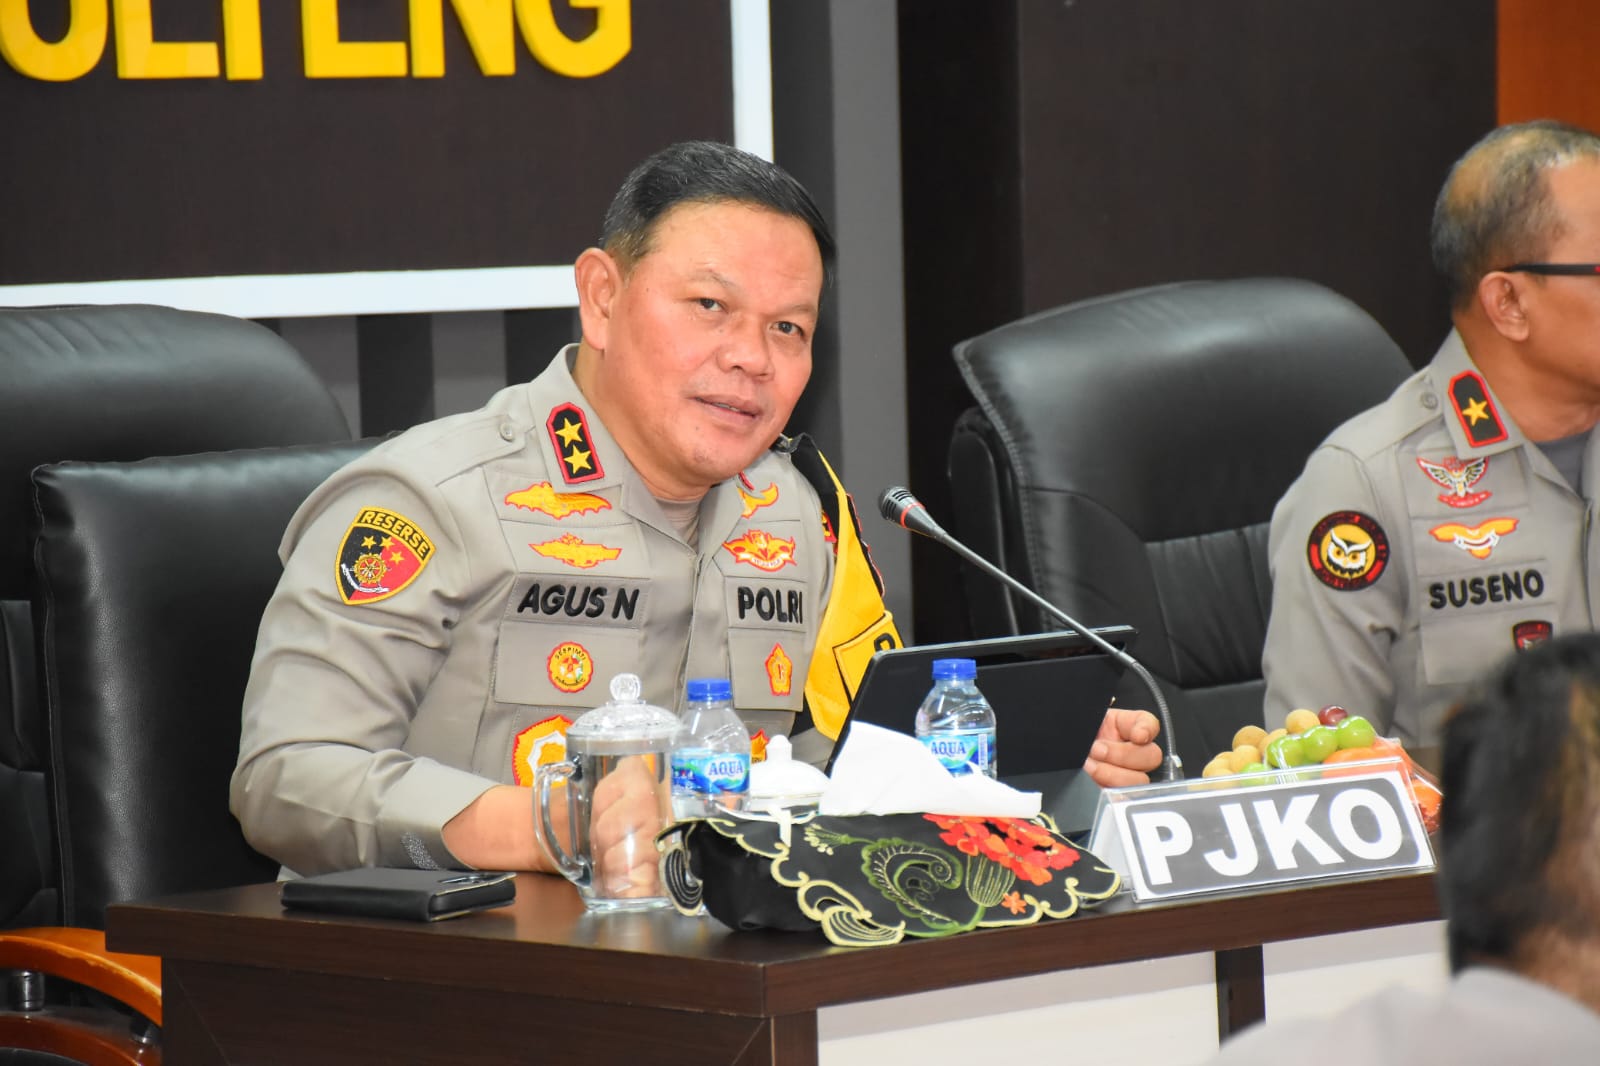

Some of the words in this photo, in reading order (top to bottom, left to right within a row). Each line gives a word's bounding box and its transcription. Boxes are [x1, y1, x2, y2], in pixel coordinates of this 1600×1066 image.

[361, 511, 429, 557] RESERSE
[517, 583, 607, 617] AGUS
[611, 587, 640, 620] N
[737, 586, 803, 624] POLRI
[1429, 568, 1545, 610] SUSENO
[931, 741, 967, 758] AQUA
[708, 761, 744, 777] AQUA
[1130, 788, 1404, 886] PJKO
